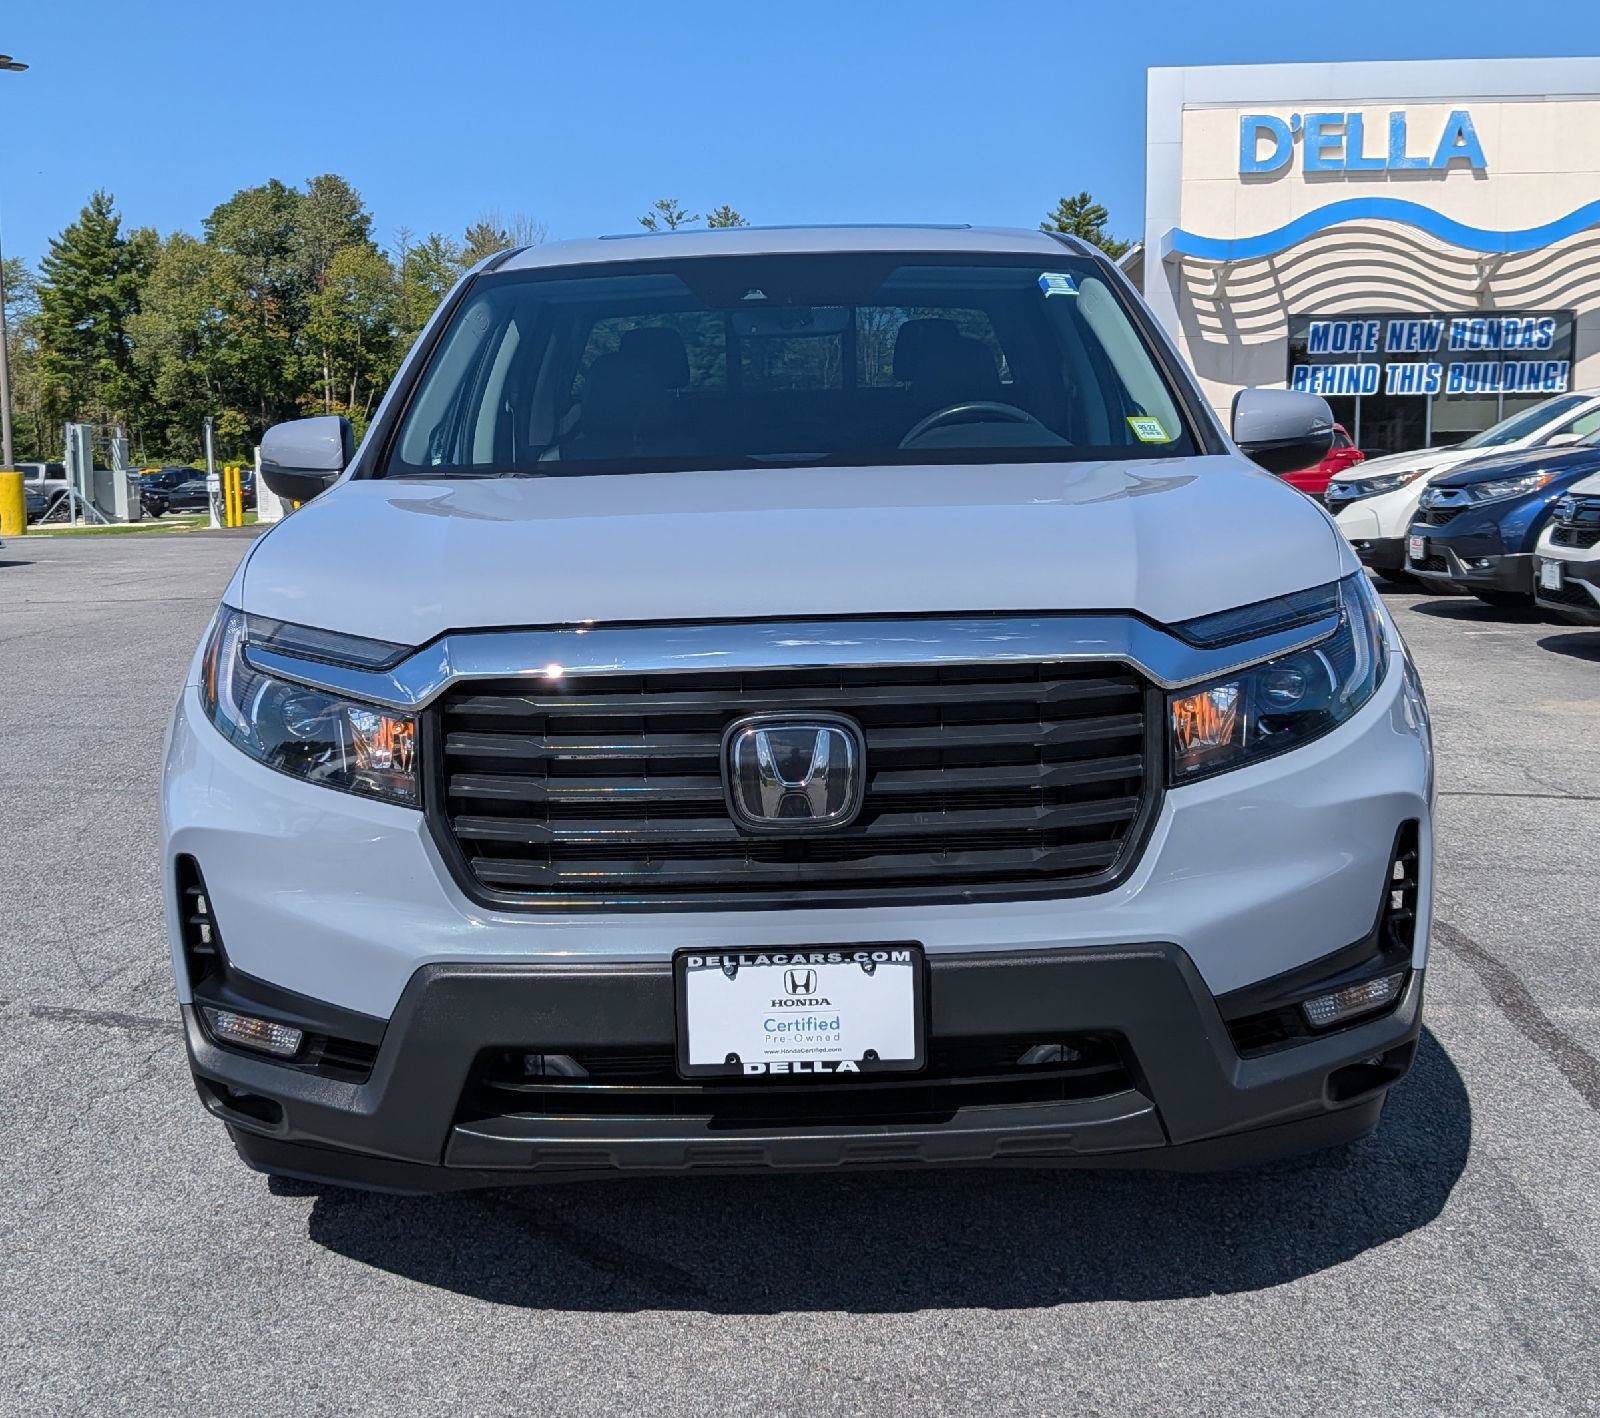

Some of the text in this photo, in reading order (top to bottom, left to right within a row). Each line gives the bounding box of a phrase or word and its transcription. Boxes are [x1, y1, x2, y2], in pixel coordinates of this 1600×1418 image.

[1239, 111, 1488, 174] D'ELLA
[1308, 317, 1556, 354] MORE NEW HONDAS
[1292, 361, 1571, 396] BEHIND THIS BUILDING!
[687, 951, 911, 967] DELLACARS.COM
[770, 998, 831, 1008] HONDA
[763, 1016, 840, 1032] Certified
[765, 1033, 840, 1043] Pre-Owned
[743, 1060, 861, 1075] DELLA
